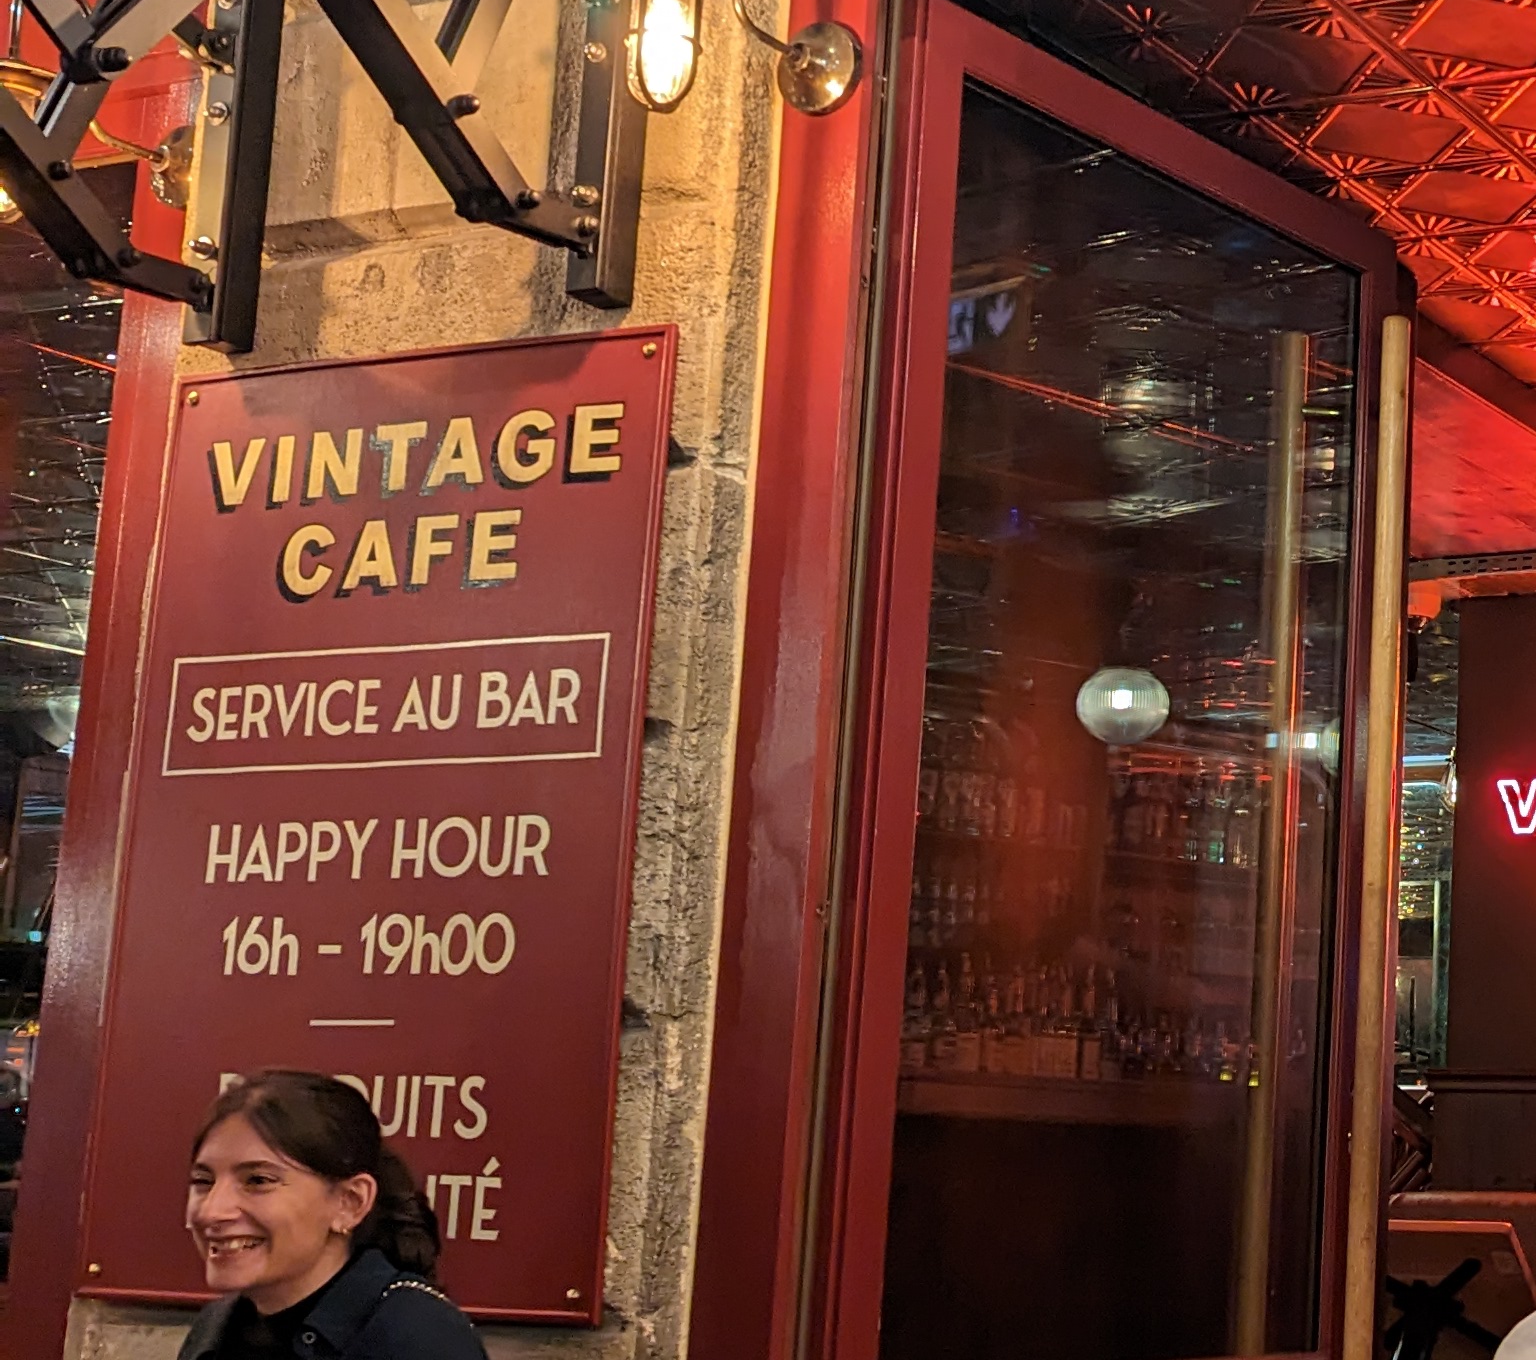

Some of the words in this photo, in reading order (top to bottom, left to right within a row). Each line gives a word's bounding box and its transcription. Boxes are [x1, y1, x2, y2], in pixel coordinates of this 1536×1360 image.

[208, 401, 625, 511] VINTAGE
[277, 508, 523, 603] CAFE
[186, 678, 381, 742] SERVICE
[393, 673, 463, 731] AU
[476, 668, 581, 728] BAR
[204, 817, 378, 883] HAPPY
[390, 814, 551, 879] HOUR
[222, 915, 299, 975] 16h
[360, 912, 516, 976] 19h00
